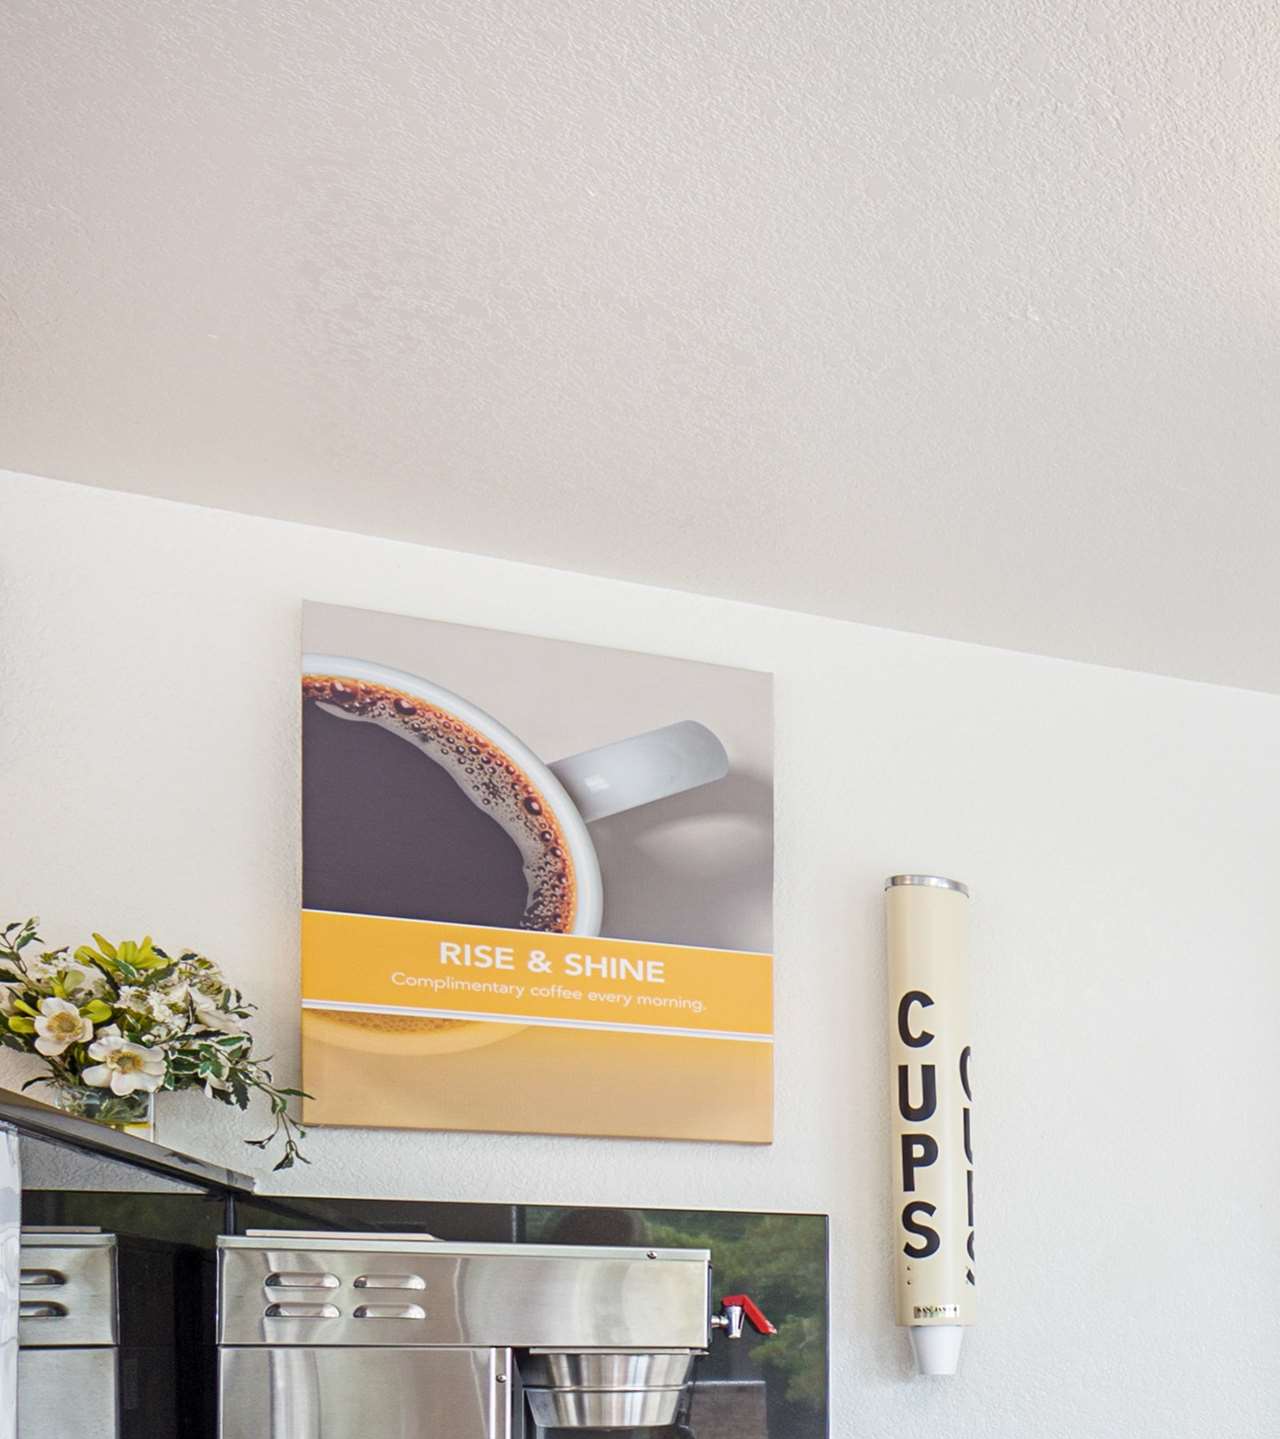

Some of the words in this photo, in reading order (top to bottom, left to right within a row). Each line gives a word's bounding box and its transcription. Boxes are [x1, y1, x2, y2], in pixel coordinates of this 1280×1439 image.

[439, 941, 514, 970] RISE
[527, 950, 552, 974] &
[564, 952, 666, 984] SHINE
[391, 971, 526, 998] Complimentary
[530, 984, 583, 1001] coffee
[587, 990, 632, 1006] every
[637, 995, 706, 1013] morning.
[897, 990, 941, 1260] CUPS
